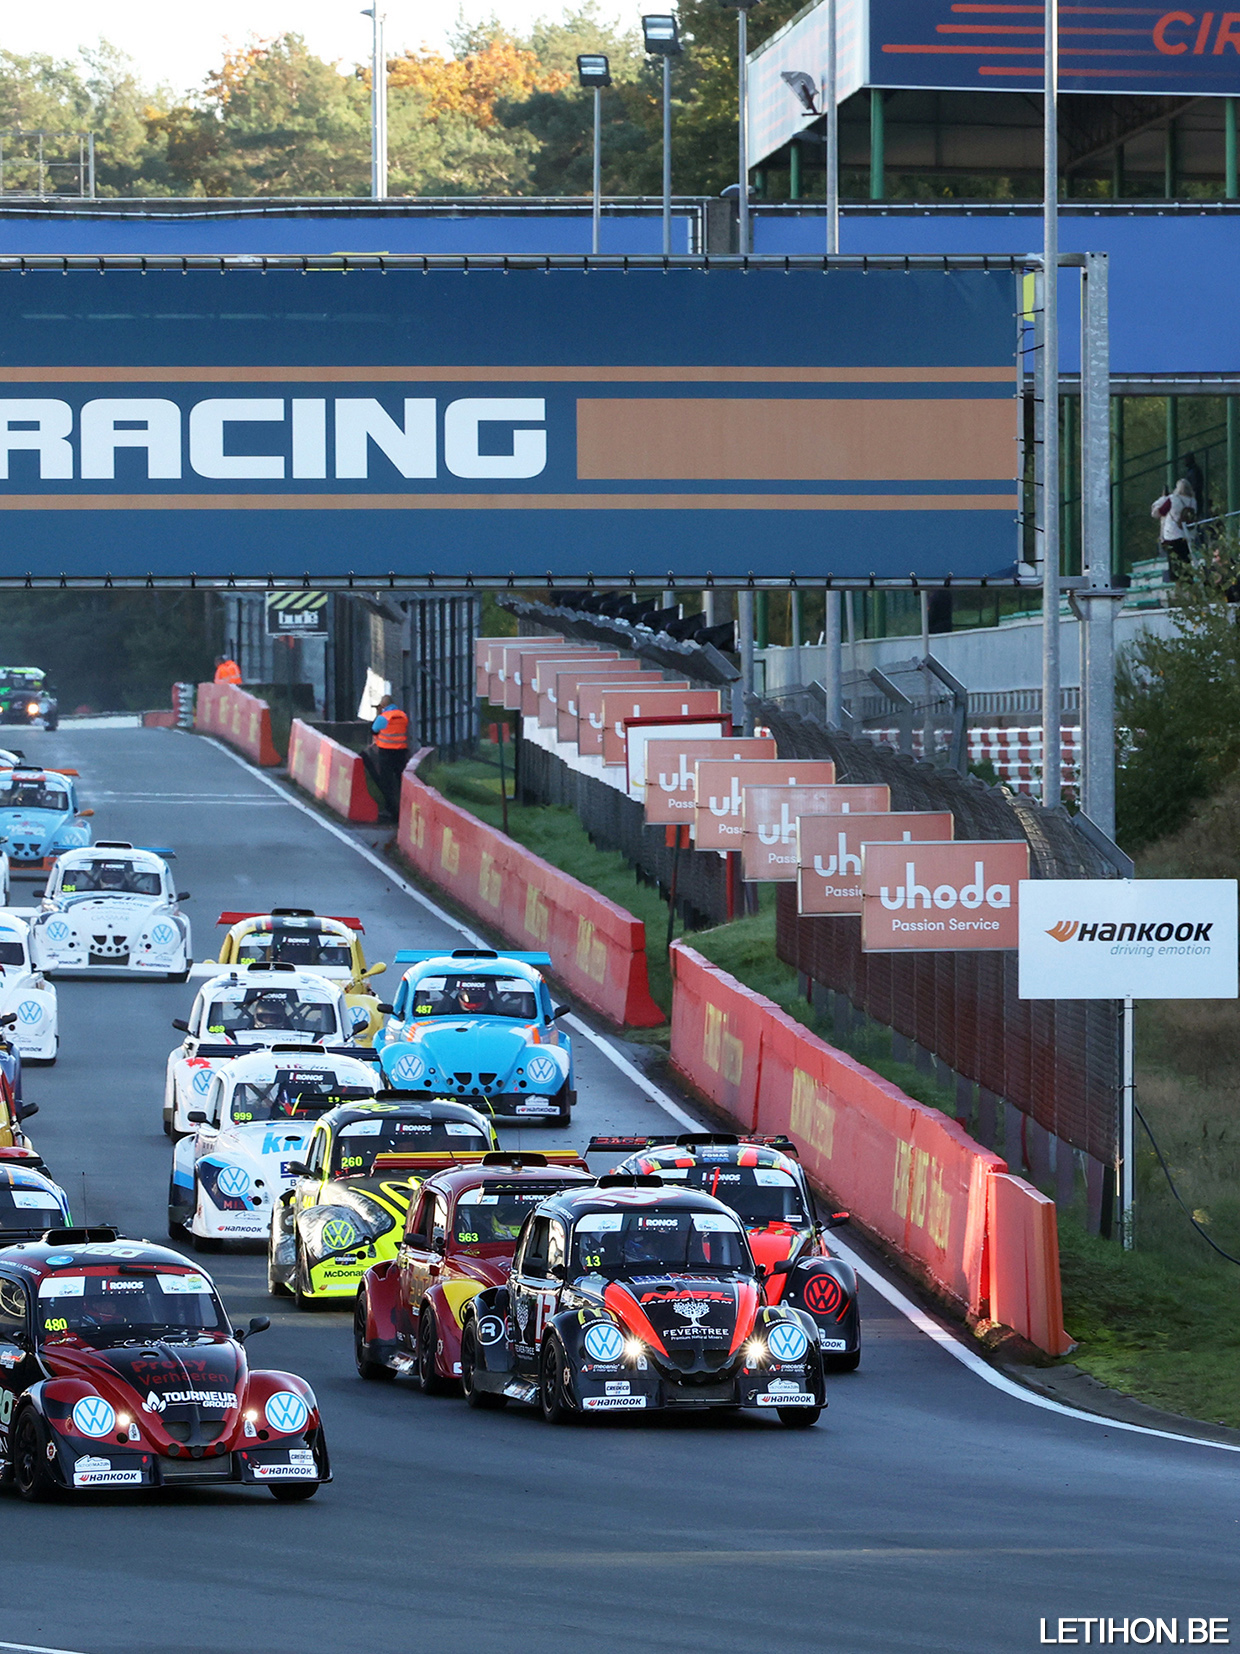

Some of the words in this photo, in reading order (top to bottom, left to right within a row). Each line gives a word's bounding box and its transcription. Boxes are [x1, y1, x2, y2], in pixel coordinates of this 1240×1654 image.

[880, 862, 1010, 910] uhoda
[892, 919, 945, 931] Passion
[949, 918, 1000, 931] Service
[1110, 944, 1153, 957] driving
[1157, 946, 1210, 956] emotion
[415, 1005, 432, 1014] 487
[233, 1112, 253, 1121] 999
[341, 1156, 363, 1168] 260
[458, 1232, 479, 1242] 563
[585, 1255, 601, 1266] 13
[44, 1318, 68, 1331] 480
[137, 1371, 229, 1386] Verhaeren
[162, 1391, 237, 1402] TOURNEUR
[203, 1401, 238, 1409] GROUPE
